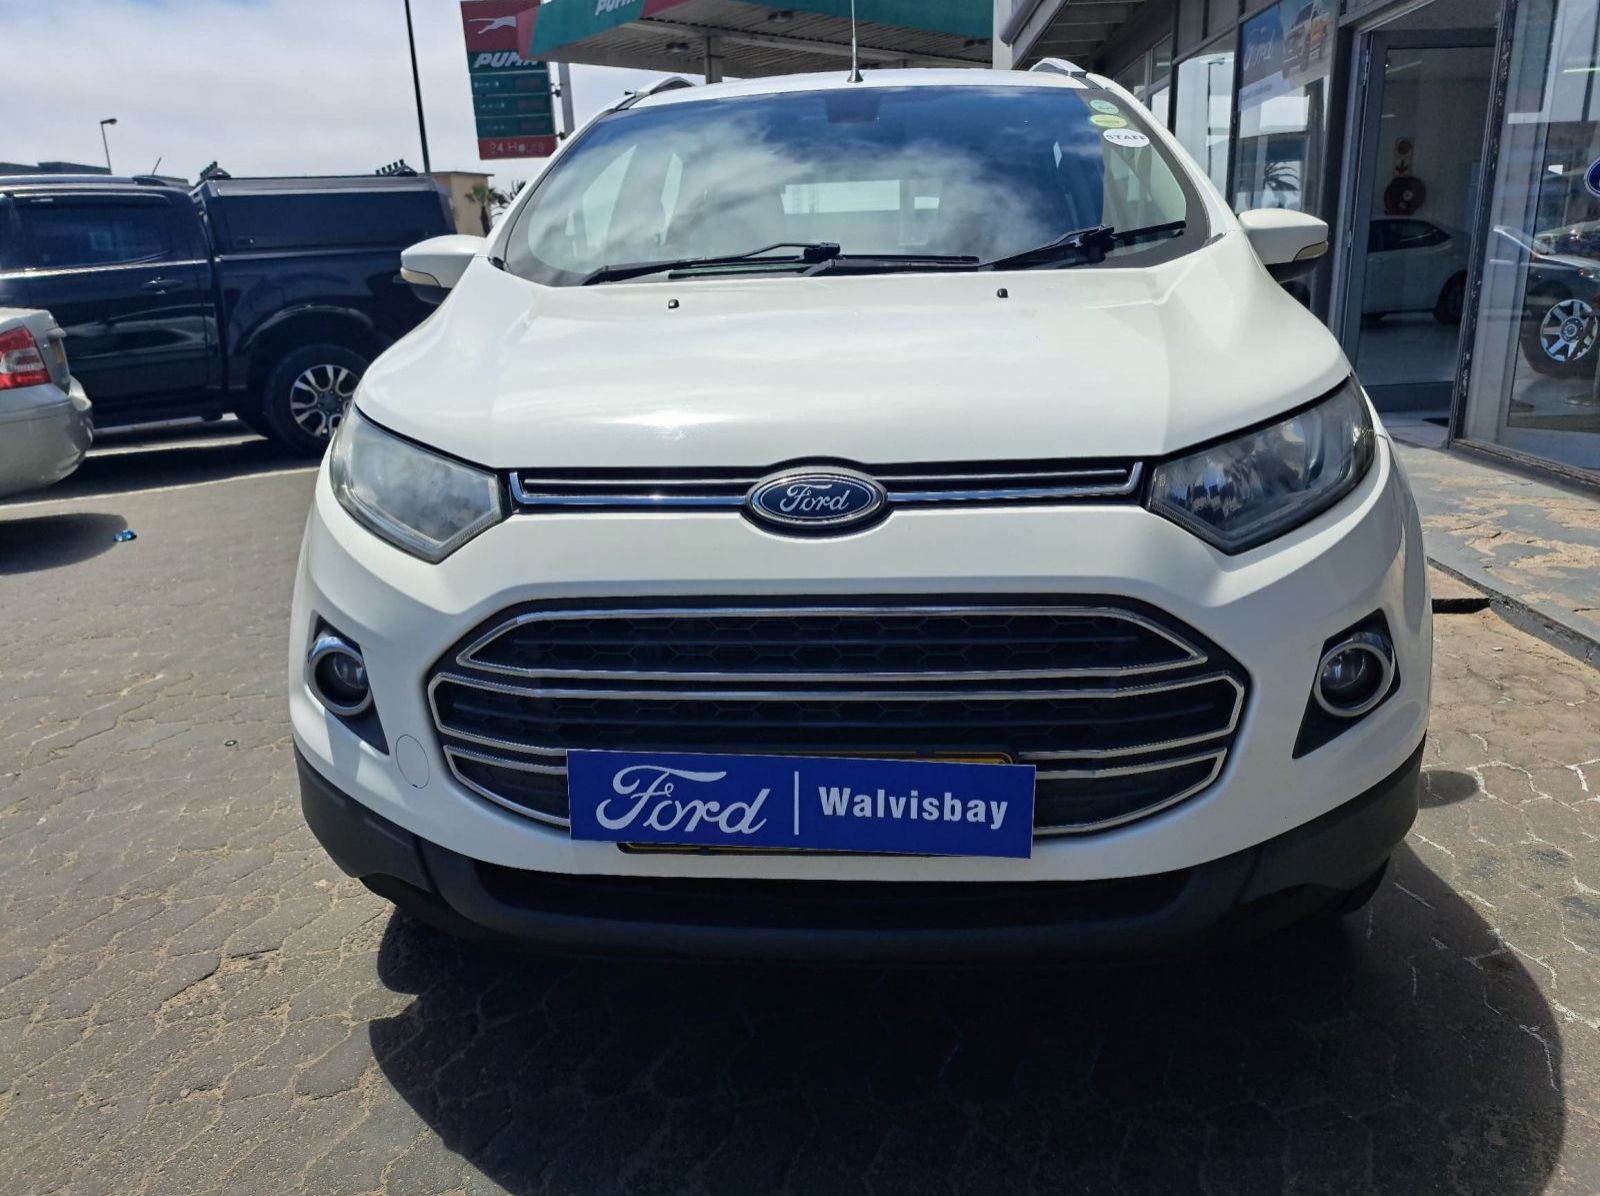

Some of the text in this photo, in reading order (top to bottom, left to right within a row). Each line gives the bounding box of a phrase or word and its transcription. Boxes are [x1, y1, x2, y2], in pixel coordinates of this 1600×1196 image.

[1105, 133, 1147, 141] STAFF
[779, 484, 850, 512] Ford
[596, 765, 1008, 834] Ford Walvisbay
